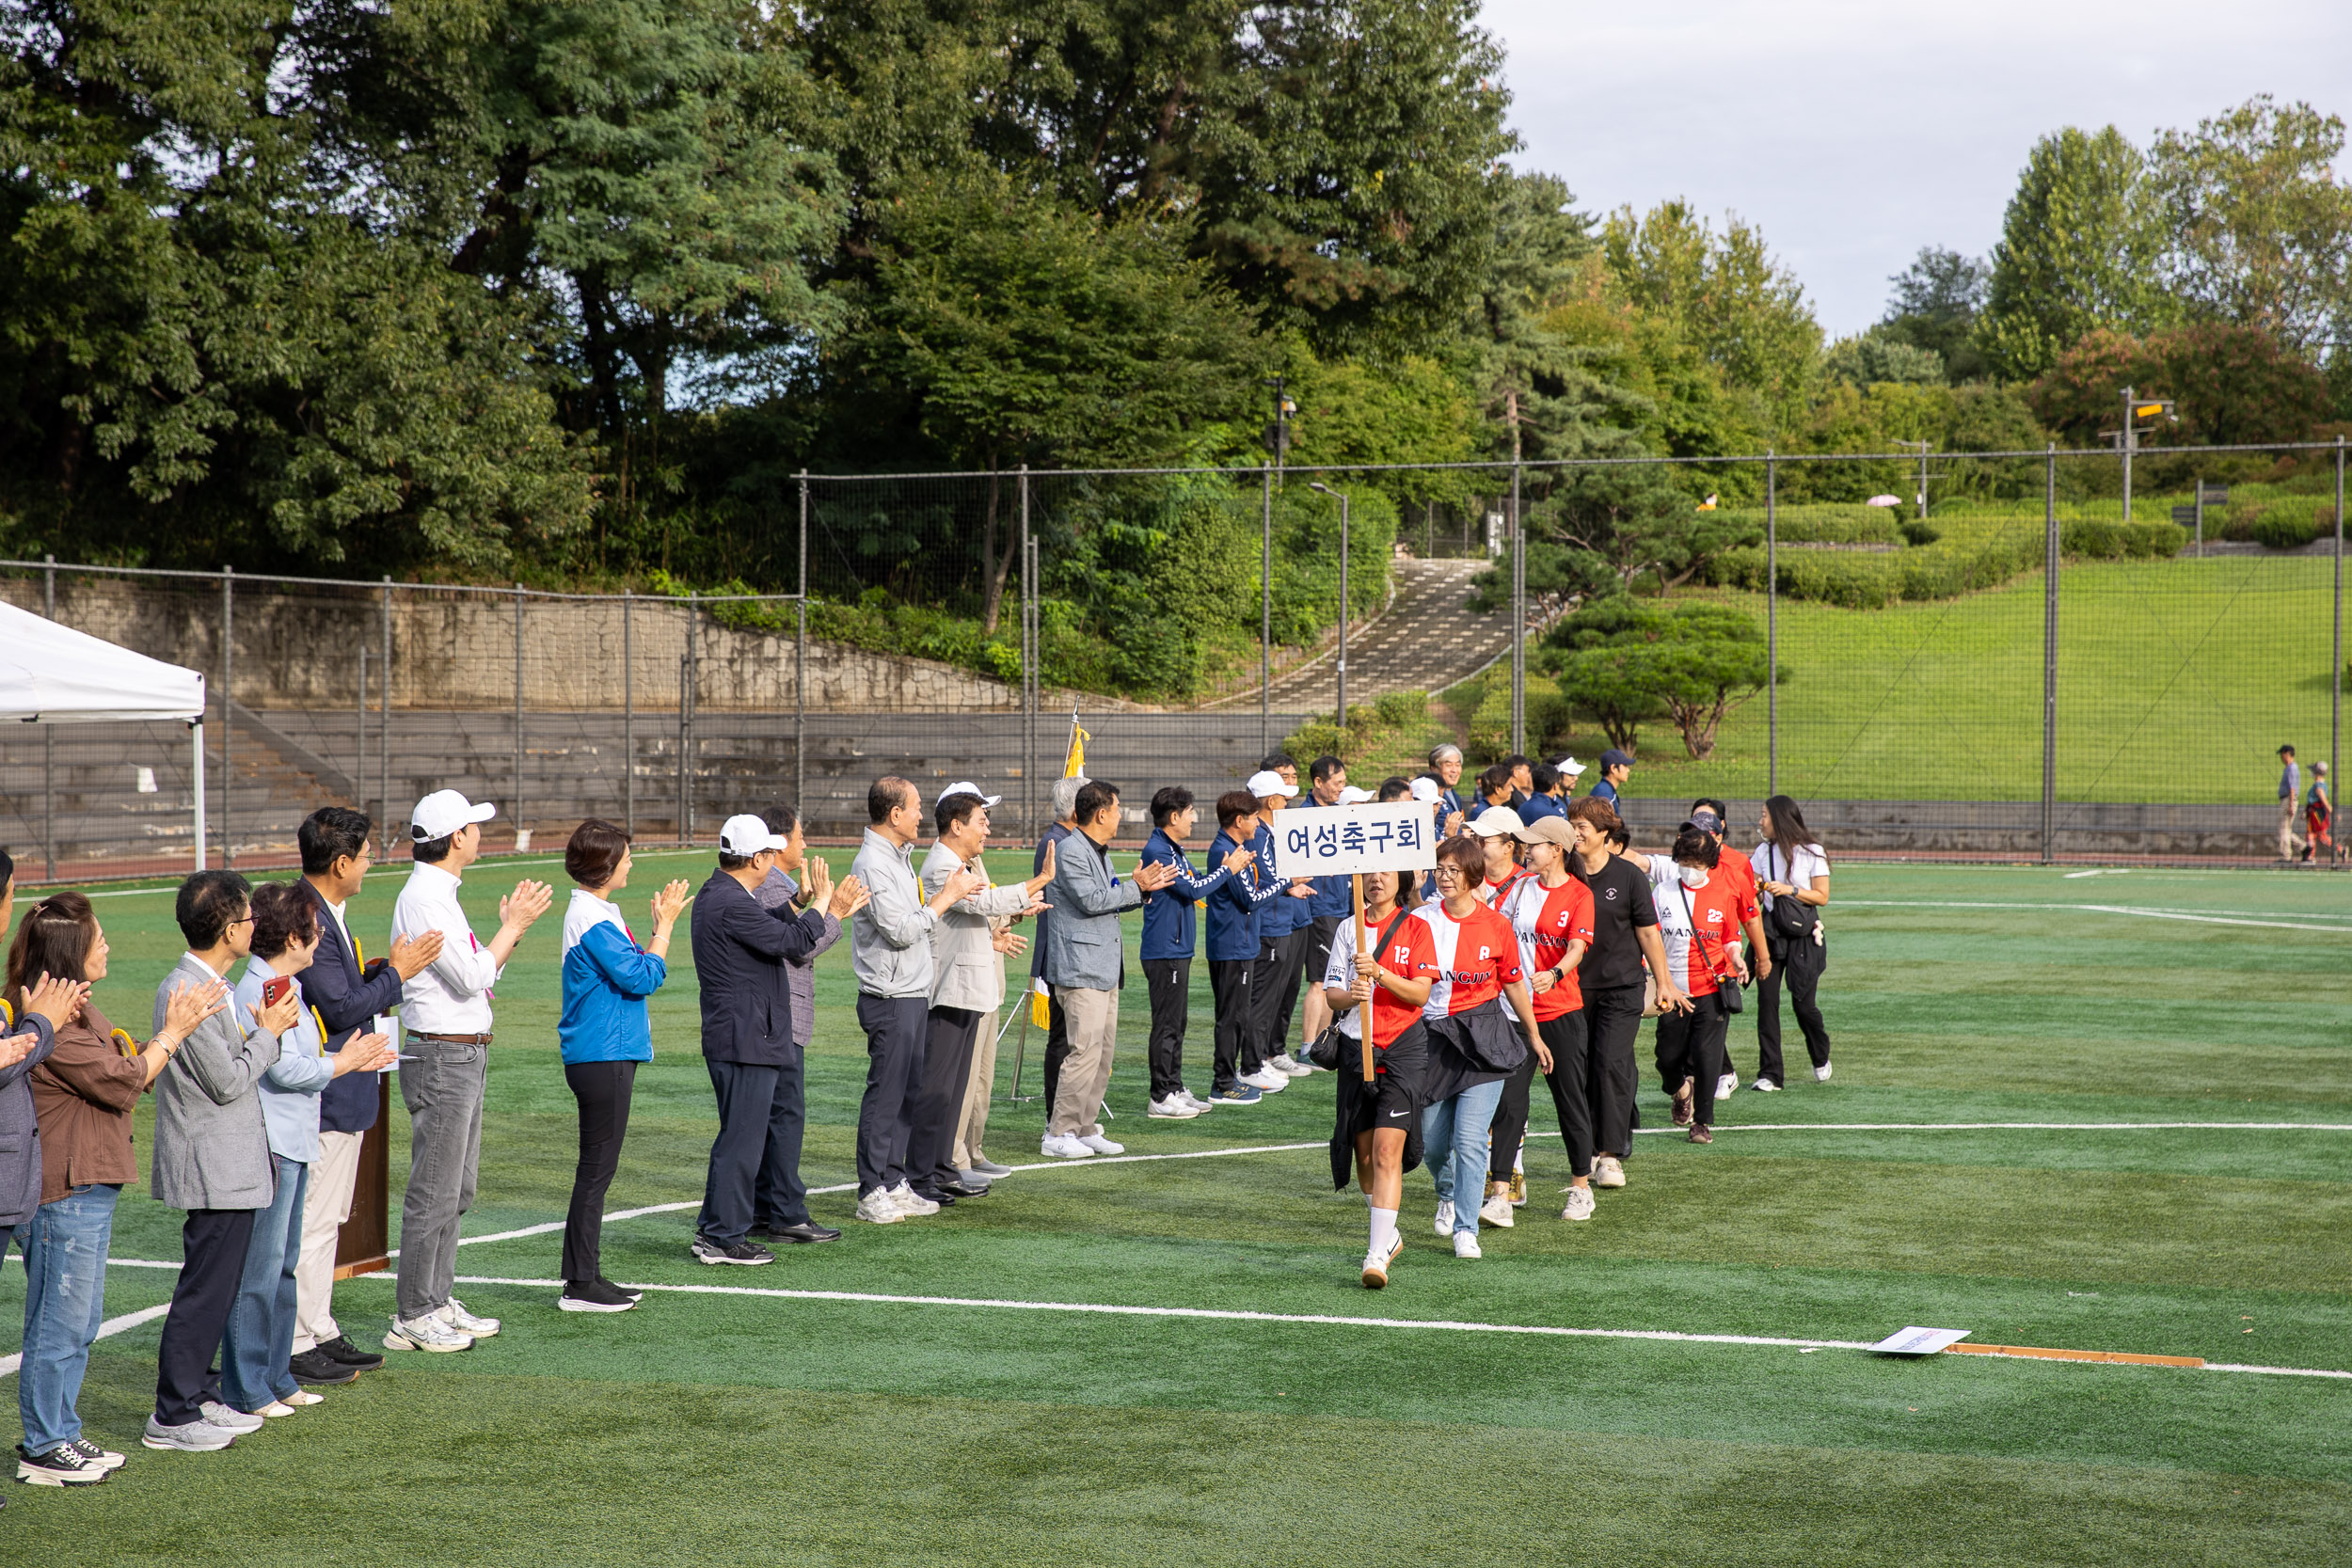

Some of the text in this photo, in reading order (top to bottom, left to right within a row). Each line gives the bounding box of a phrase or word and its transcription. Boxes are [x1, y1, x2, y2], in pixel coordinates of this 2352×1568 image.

[1287, 817, 1421, 859] 여성축구회
[1557, 911, 1569, 927] 3
[1707, 908, 1724, 923] 22
[1394, 945, 1410, 965] 12
